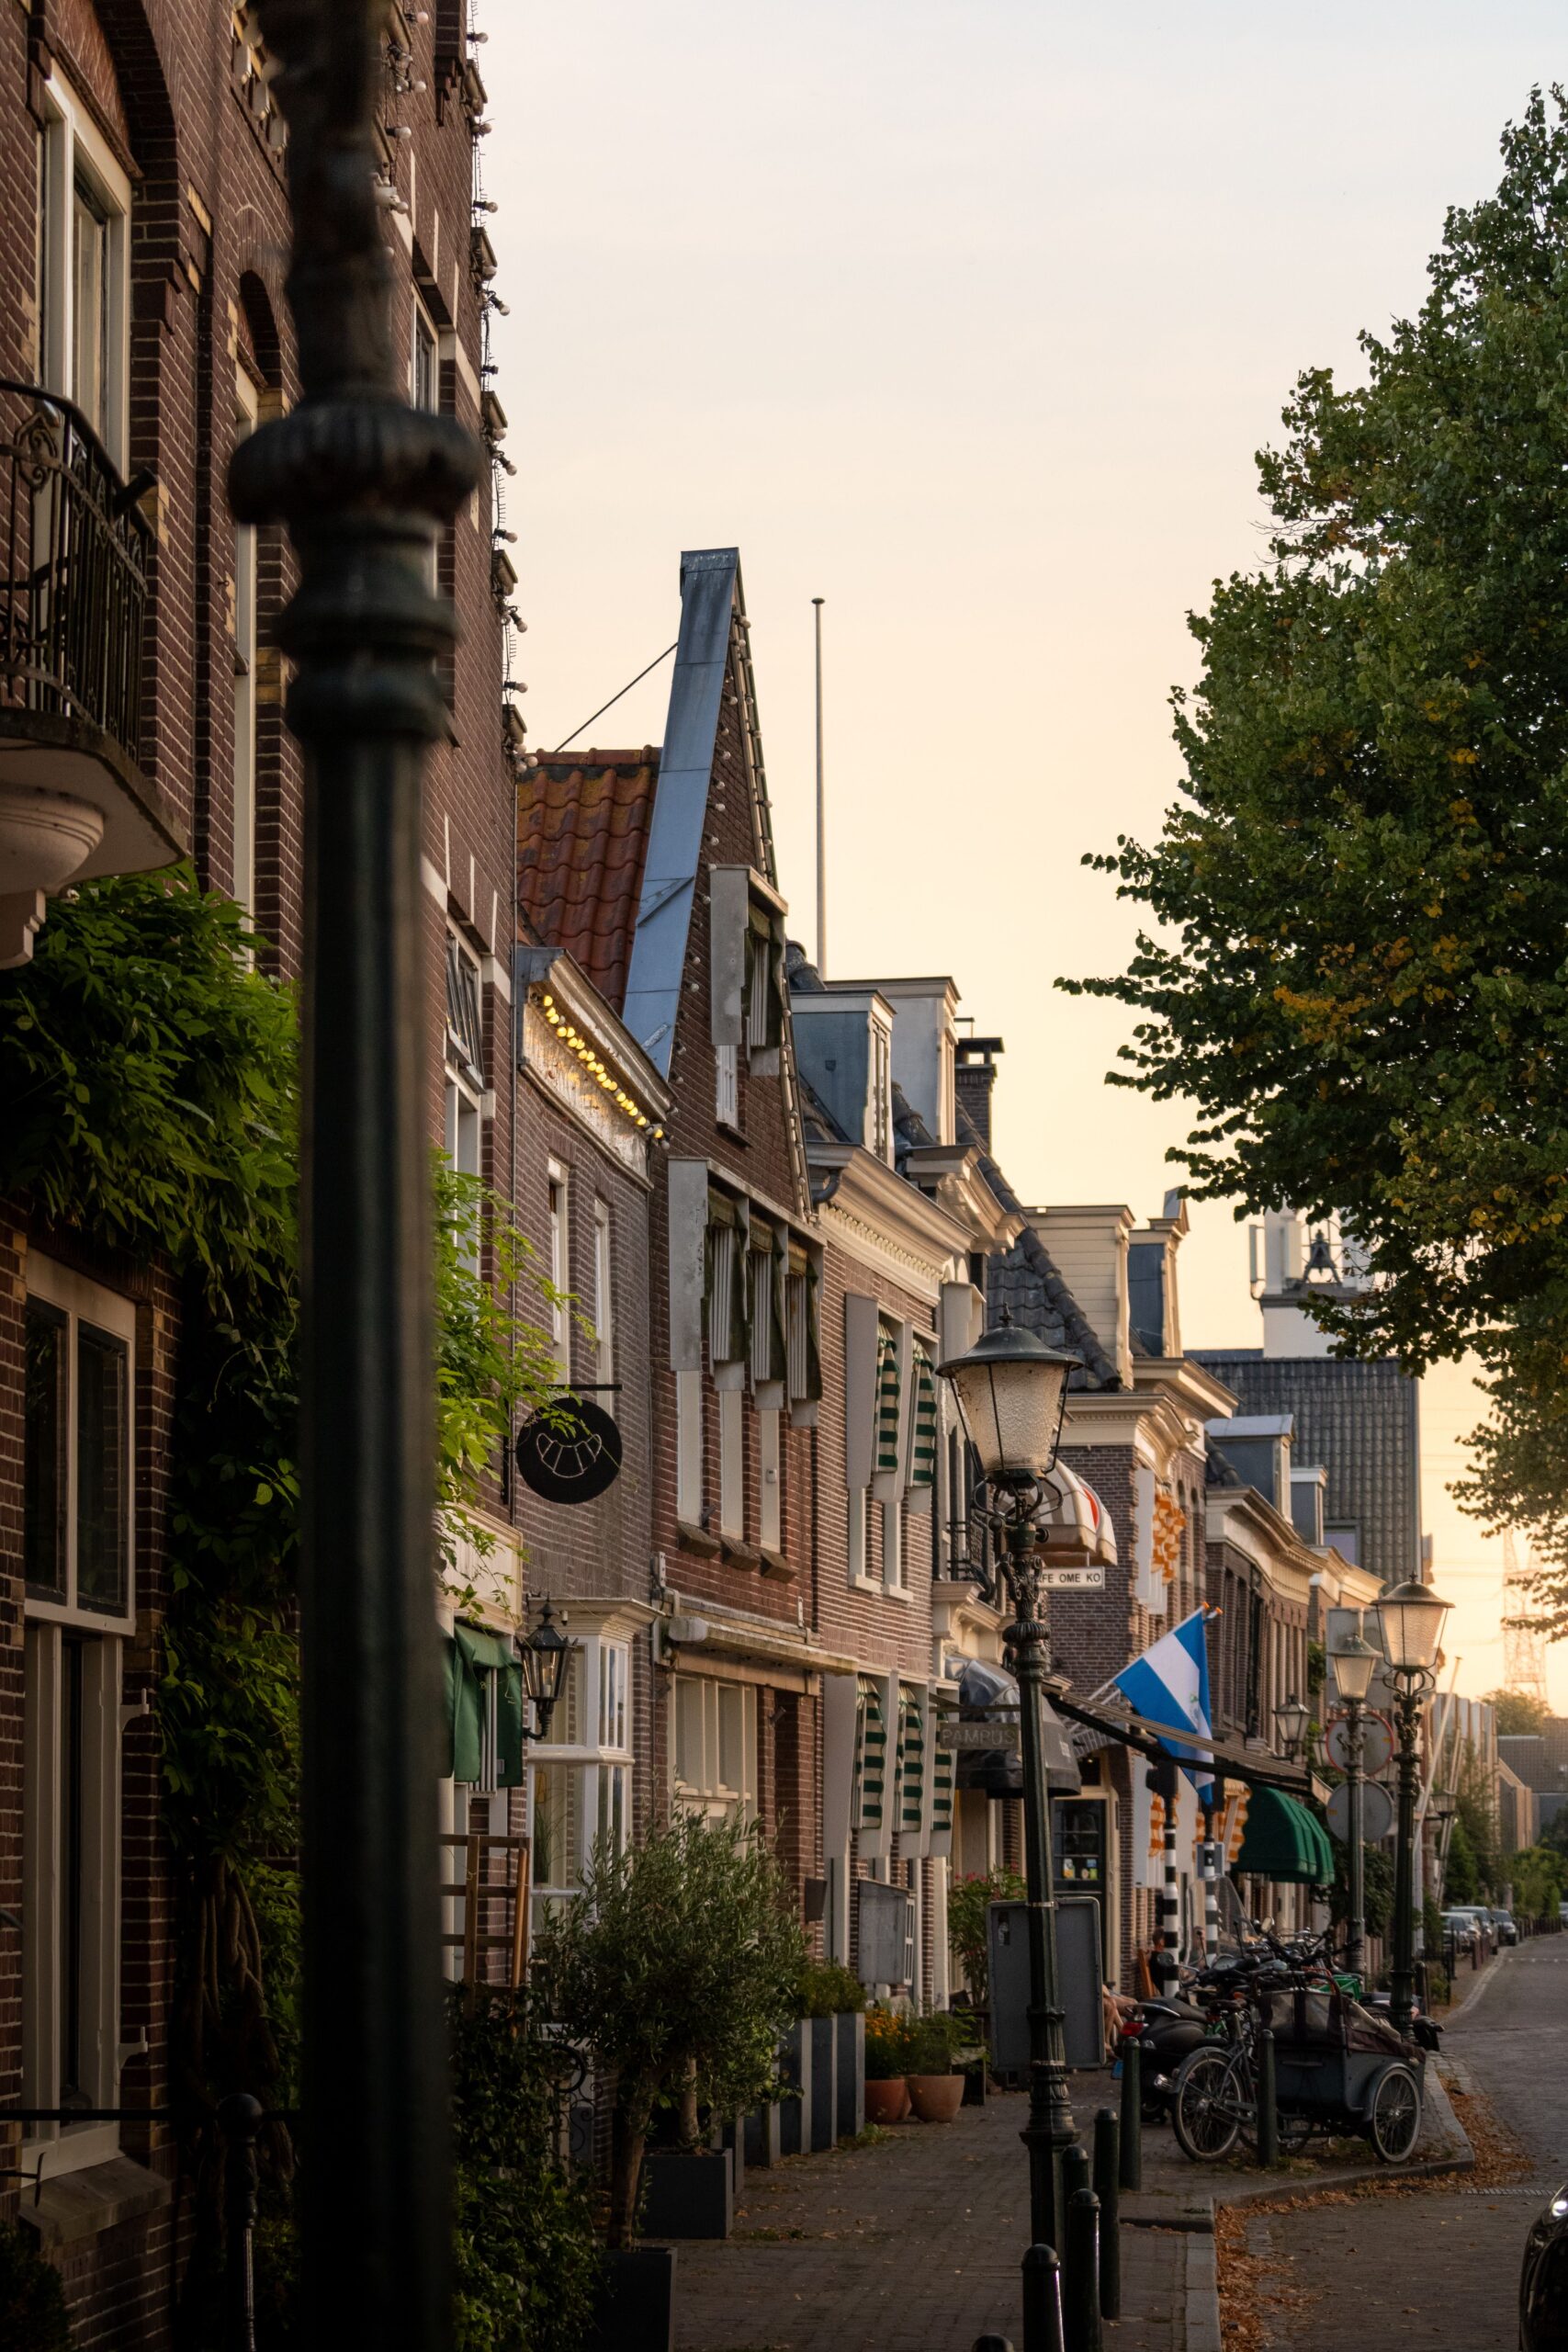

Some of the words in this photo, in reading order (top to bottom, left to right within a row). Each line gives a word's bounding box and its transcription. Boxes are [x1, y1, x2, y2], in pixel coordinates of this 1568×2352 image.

[1059, 1573, 1080, 1583] OME
[1087, 1573, 1101, 1582] KO
[942, 1728, 1015, 1745] PAMPUS
